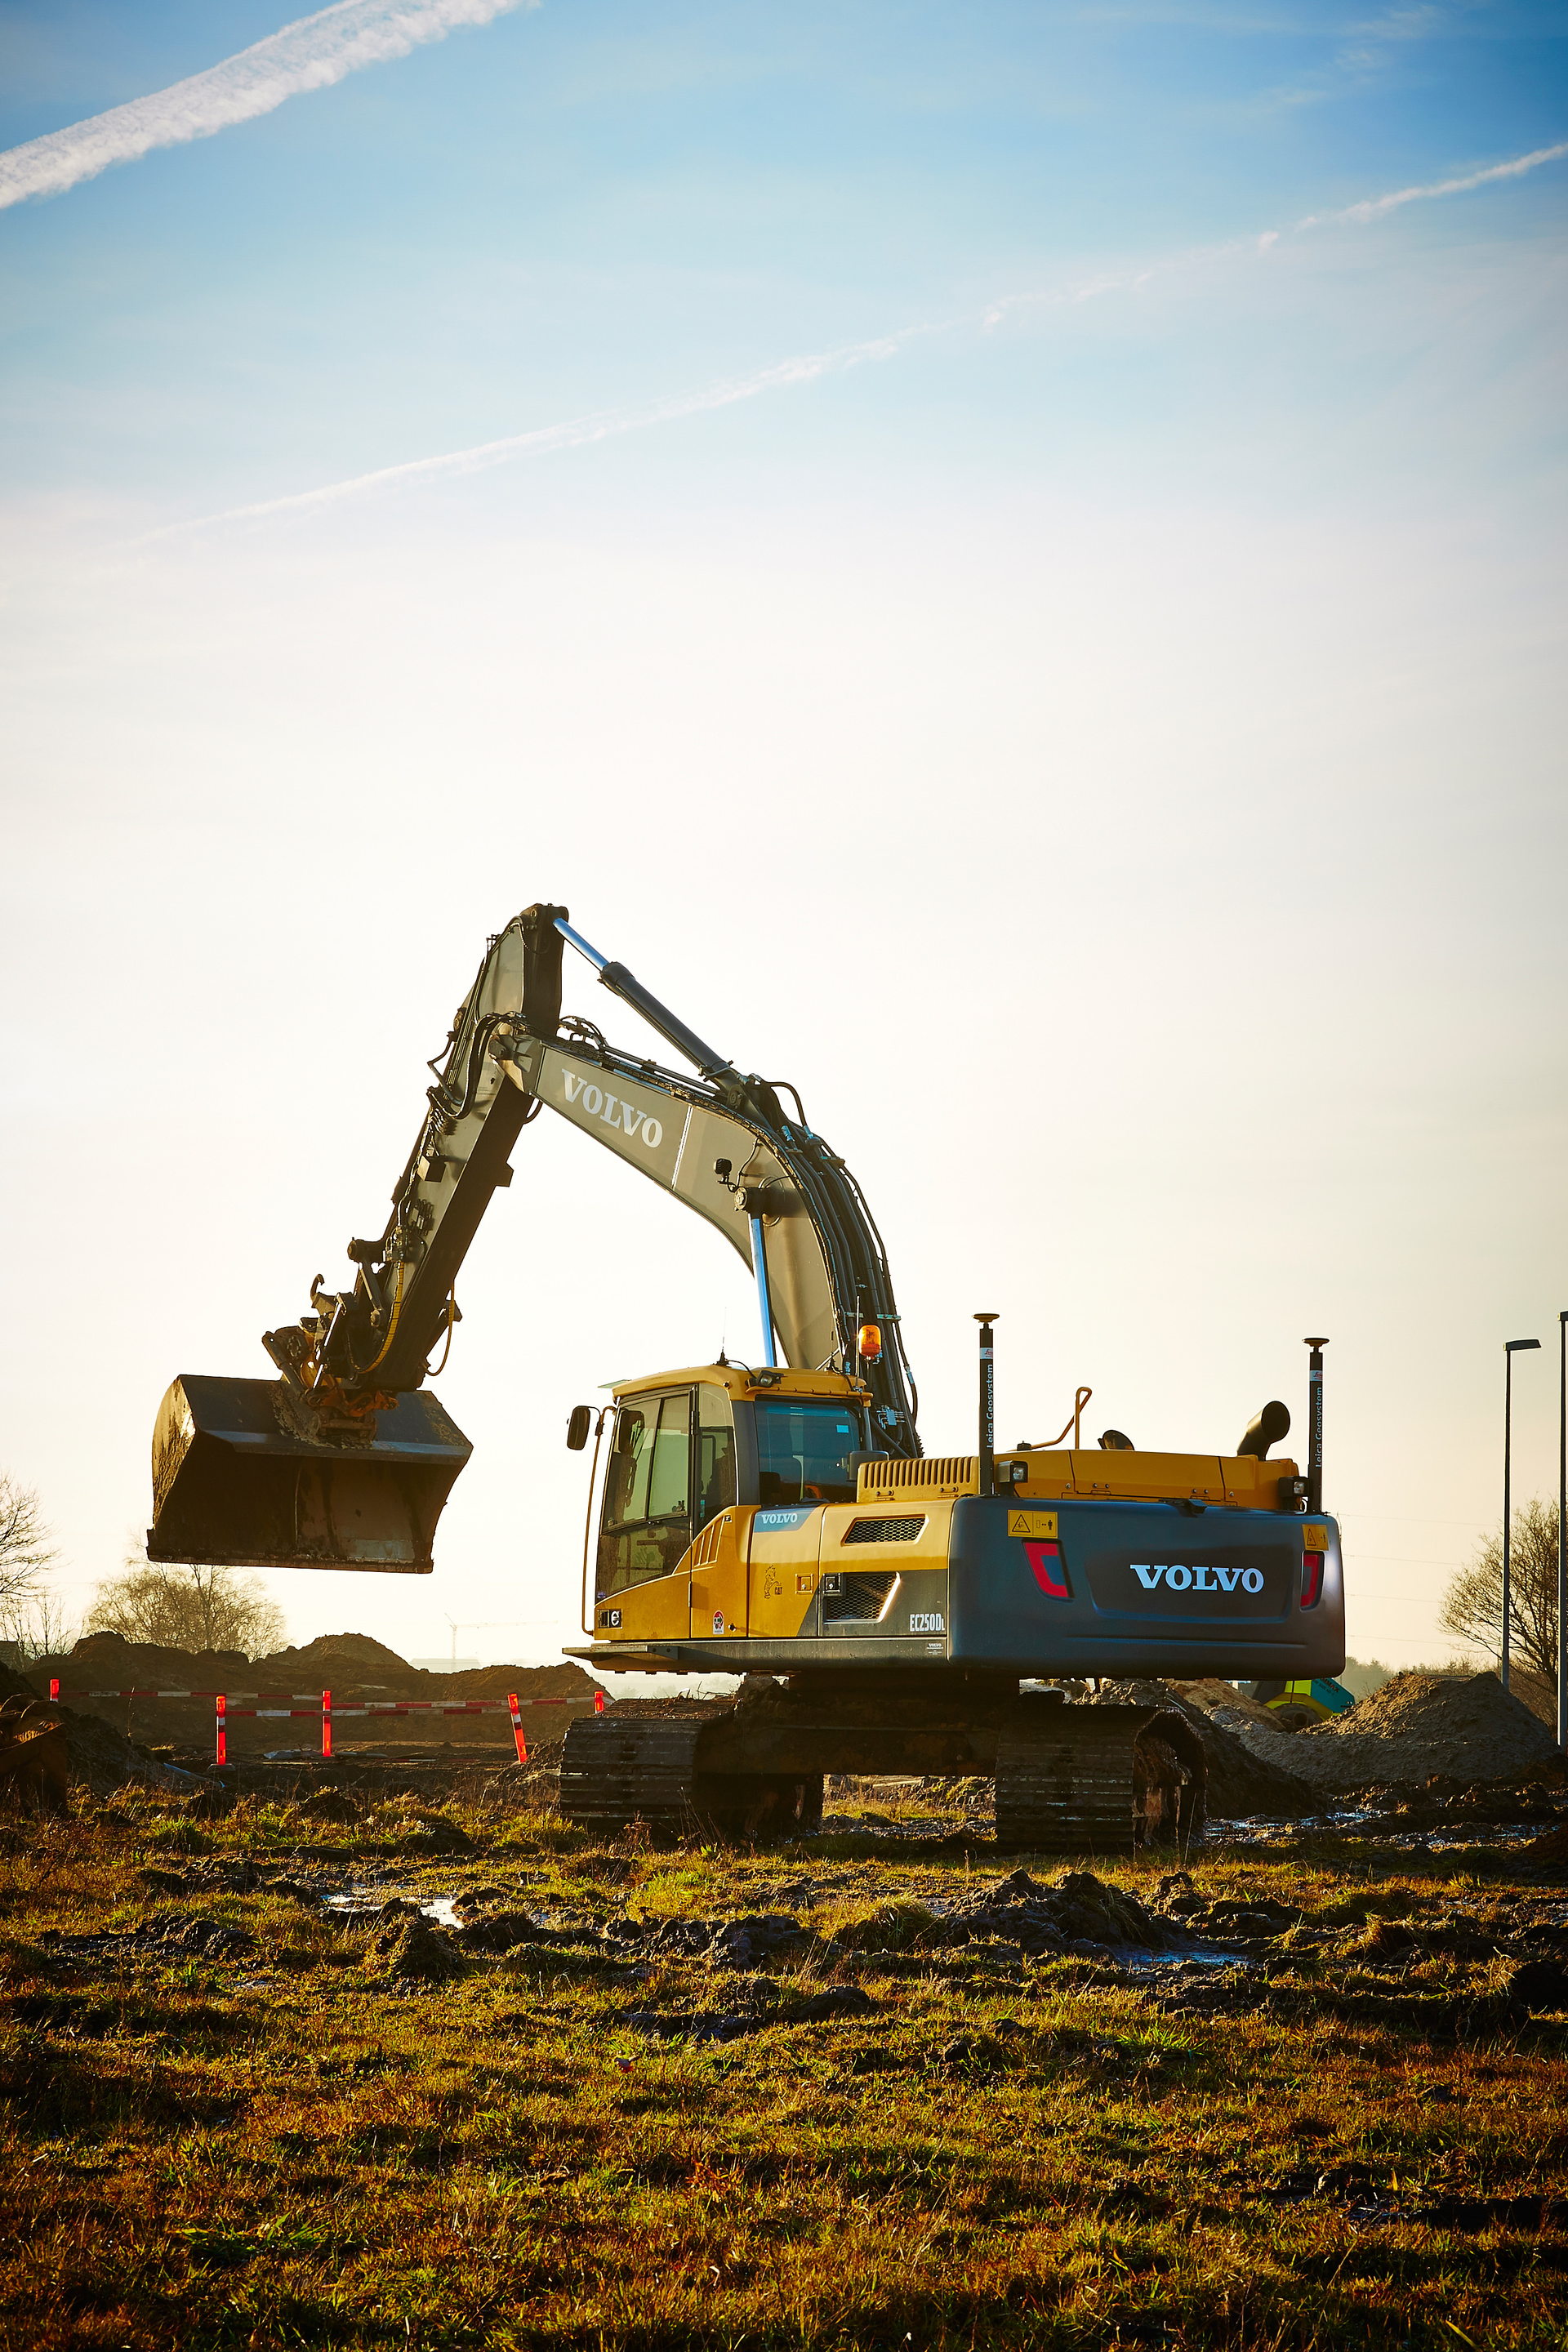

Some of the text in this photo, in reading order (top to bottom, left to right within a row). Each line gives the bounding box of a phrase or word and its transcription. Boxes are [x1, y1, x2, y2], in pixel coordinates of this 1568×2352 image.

[561, 1068, 663, 1148] VOLVO
[761, 1513, 798, 1525] VOLVO
[1129, 1564, 1264, 1593] VOLVO
[909, 1613, 946, 1632] EC250DL
